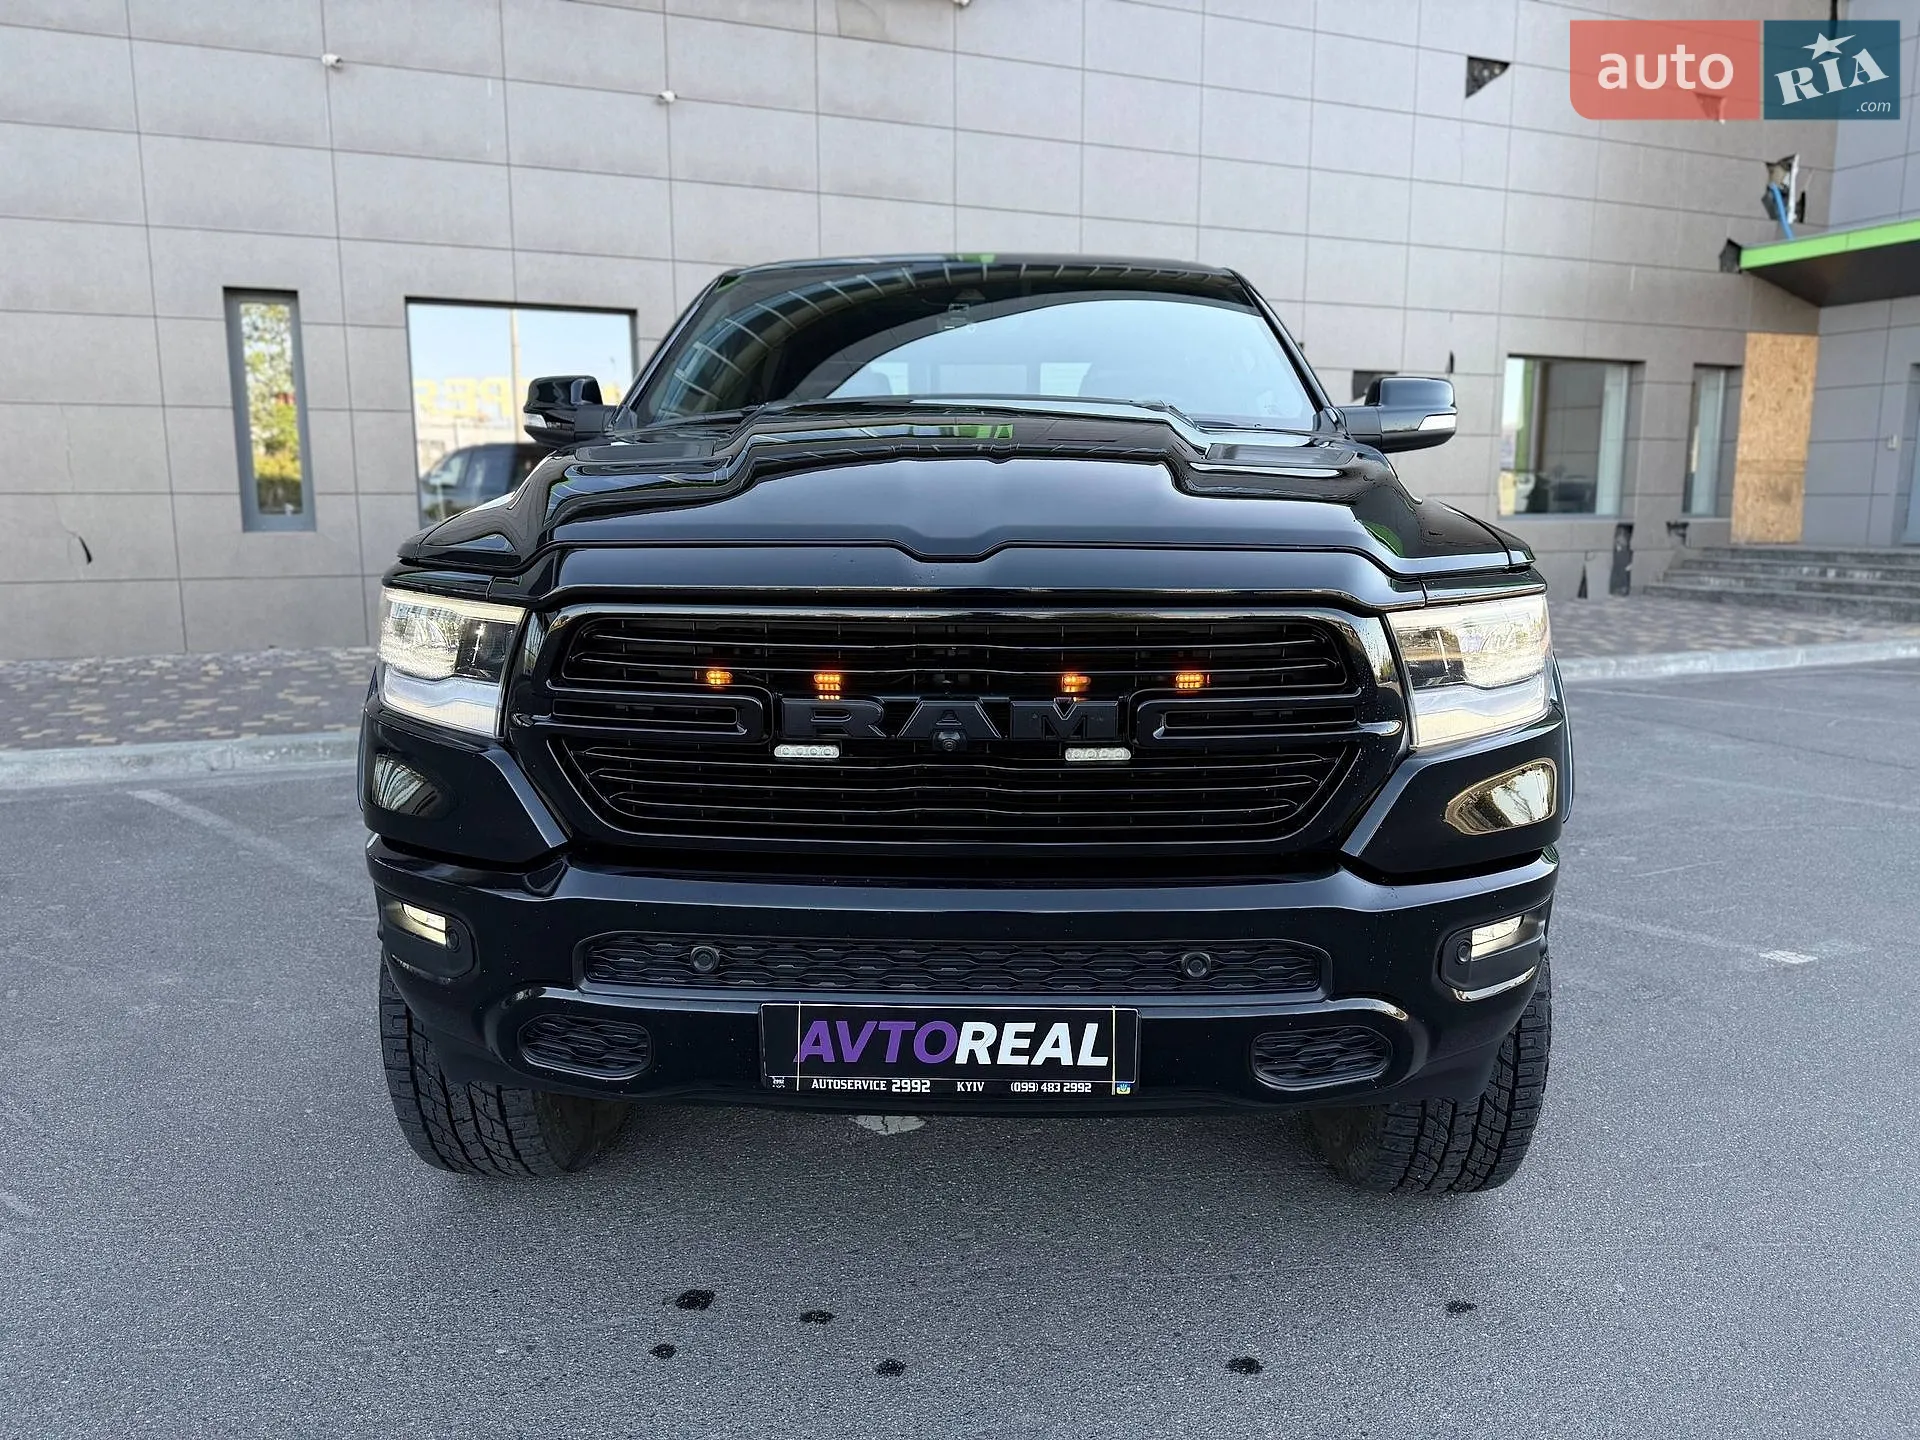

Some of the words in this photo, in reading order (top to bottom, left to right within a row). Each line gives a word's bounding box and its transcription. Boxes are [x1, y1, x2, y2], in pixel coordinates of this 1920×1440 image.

[781, 698, 1118, 740] RAM
[793, 1020, 1109, 1067] AVTOREAL
[811, 1079, 887, 1091] AUTOSERVICE
[891, 1079, 931, 1093] 2992
[957, 1081, 984, 1092] KYIV
[1010, 1082, 1039, 1093] (099)
[1040, 1082, 1060, 1093] 483
[1064, 1082, 1091, 1093] 2992
